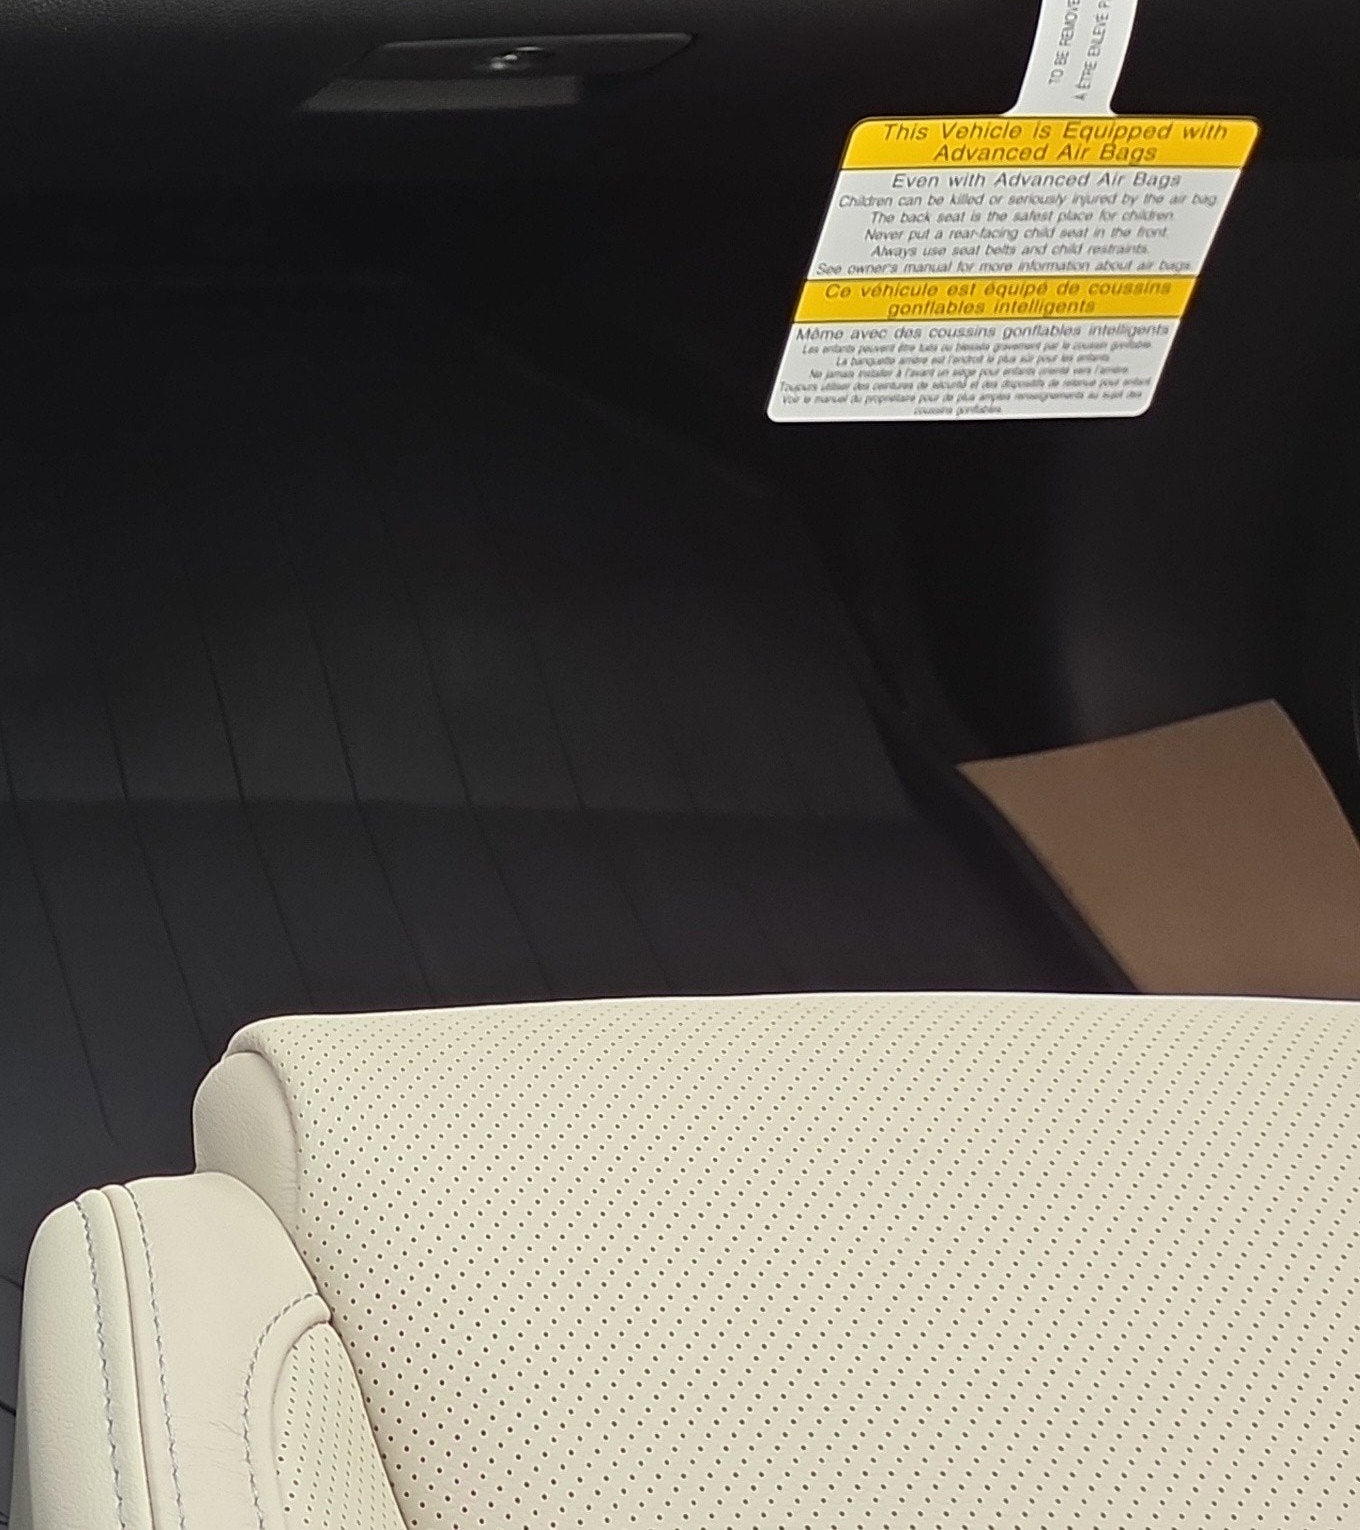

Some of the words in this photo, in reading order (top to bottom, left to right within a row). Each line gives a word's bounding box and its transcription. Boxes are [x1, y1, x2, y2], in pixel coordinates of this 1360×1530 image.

[883, 124, 928, 141] This
[942, 122, 1022, 140] Vehicle
[1033, 123, 1051, 140] is
[1063, 122, 1173, 143] Equipped
[1183, 122, 1228, 140] with
[933, 144, 1045, 162] Advanced
[1057, 144, 1092, 161] Air
[1100, 144, 1157, 164] Bags
[892, 173, 938, 189] Even
[949, 173, 986, 188] with
[993, 172, 1091, 187] Advanced
[1096, 172, 1126, 187] Air
[1133, 172, 1181, 190] Bags
[838, 195, 893, 208] Children
[898, 196, 922, 207] can
[928, 195, 944, 206] be
[949, 193, 984, 205] killed
[988, 195, 1002, 205] or
[1007, 193, 1066, 207] seriously
[1072, 193, 1118, 207] injured
[1121, 193, 1137, 207] by
[1143, 193, 1164, 204] the
[871, 210, 895, 224] The
[901, 211, 931, 223] back
[936, 211, 966, 223] seat
[987, 210, 1008, 221] the
[1013, 210, 1054, 221] safest
[1057, 209, 1093, 223] place
[865, 228, 903, 241] Never
[907, 229, 930, 243] put
[1023, 227, 1055, 239] child
[1059, 227, 1089, 239] seat
[870, 244, 917, 259] Always
[922, 246, 947, 257] use
[951, 245, 980, 256] seat
[985, 244, 1016, 256] belts
[1051, 243, 1083, 255] child
[904, 261, 952, 274] manual
[981, 262, 1013, 273] more
[1018, 259, 1090, 272] information
[1095, 260, 1133, 271] about
[825, 283, 851, 299] Ce
[861, 282, 938, 298] véhicule
[946, 283, 976, 297] est
[983, 280, 1049, 298] équipé
[1056, 281, 1080, 296] de
[1088, 281, 1172, 296] coussins
[887, 300, 985, 319] gonflables
[993, 299, 1096, 317] intelligents
[796, 327, 844, 341] Même
[850, 328, 888, 340] avec
[894, 327, 922, 339] des
[929, 325, 996, 338] coussins
[1002, 324, 1081, 340] gonflables
[1088, 323, 1170, 340] intelligents
